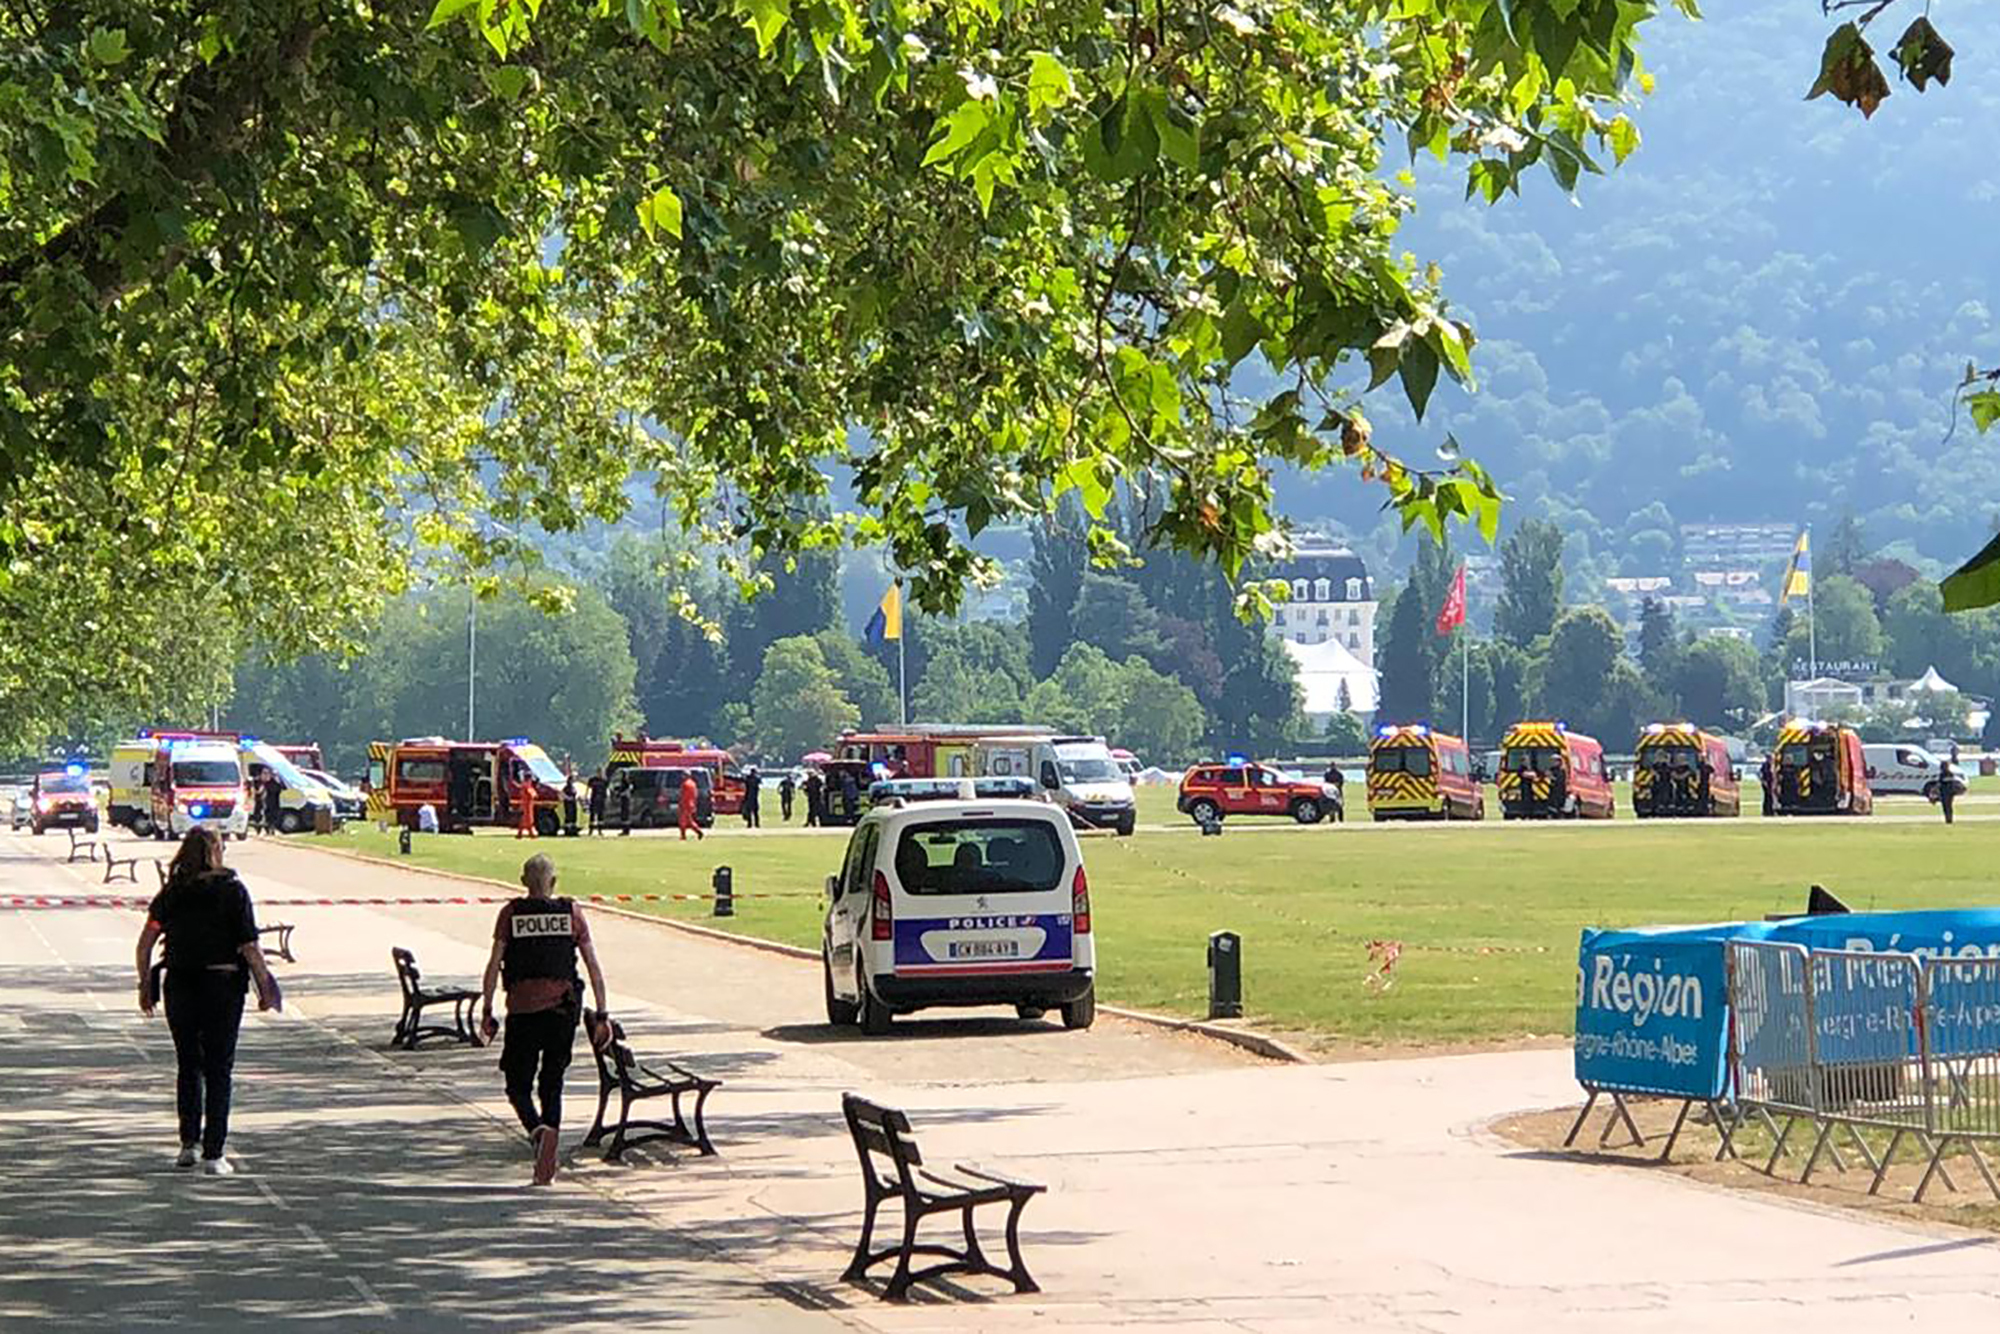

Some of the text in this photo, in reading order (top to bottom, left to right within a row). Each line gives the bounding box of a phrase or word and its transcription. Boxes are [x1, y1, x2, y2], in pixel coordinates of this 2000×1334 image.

[516, 916, 569, 934] POLICE
[949, 915, 1017, 930] POLICE
[1591, 954, 1703, 1026] Région
